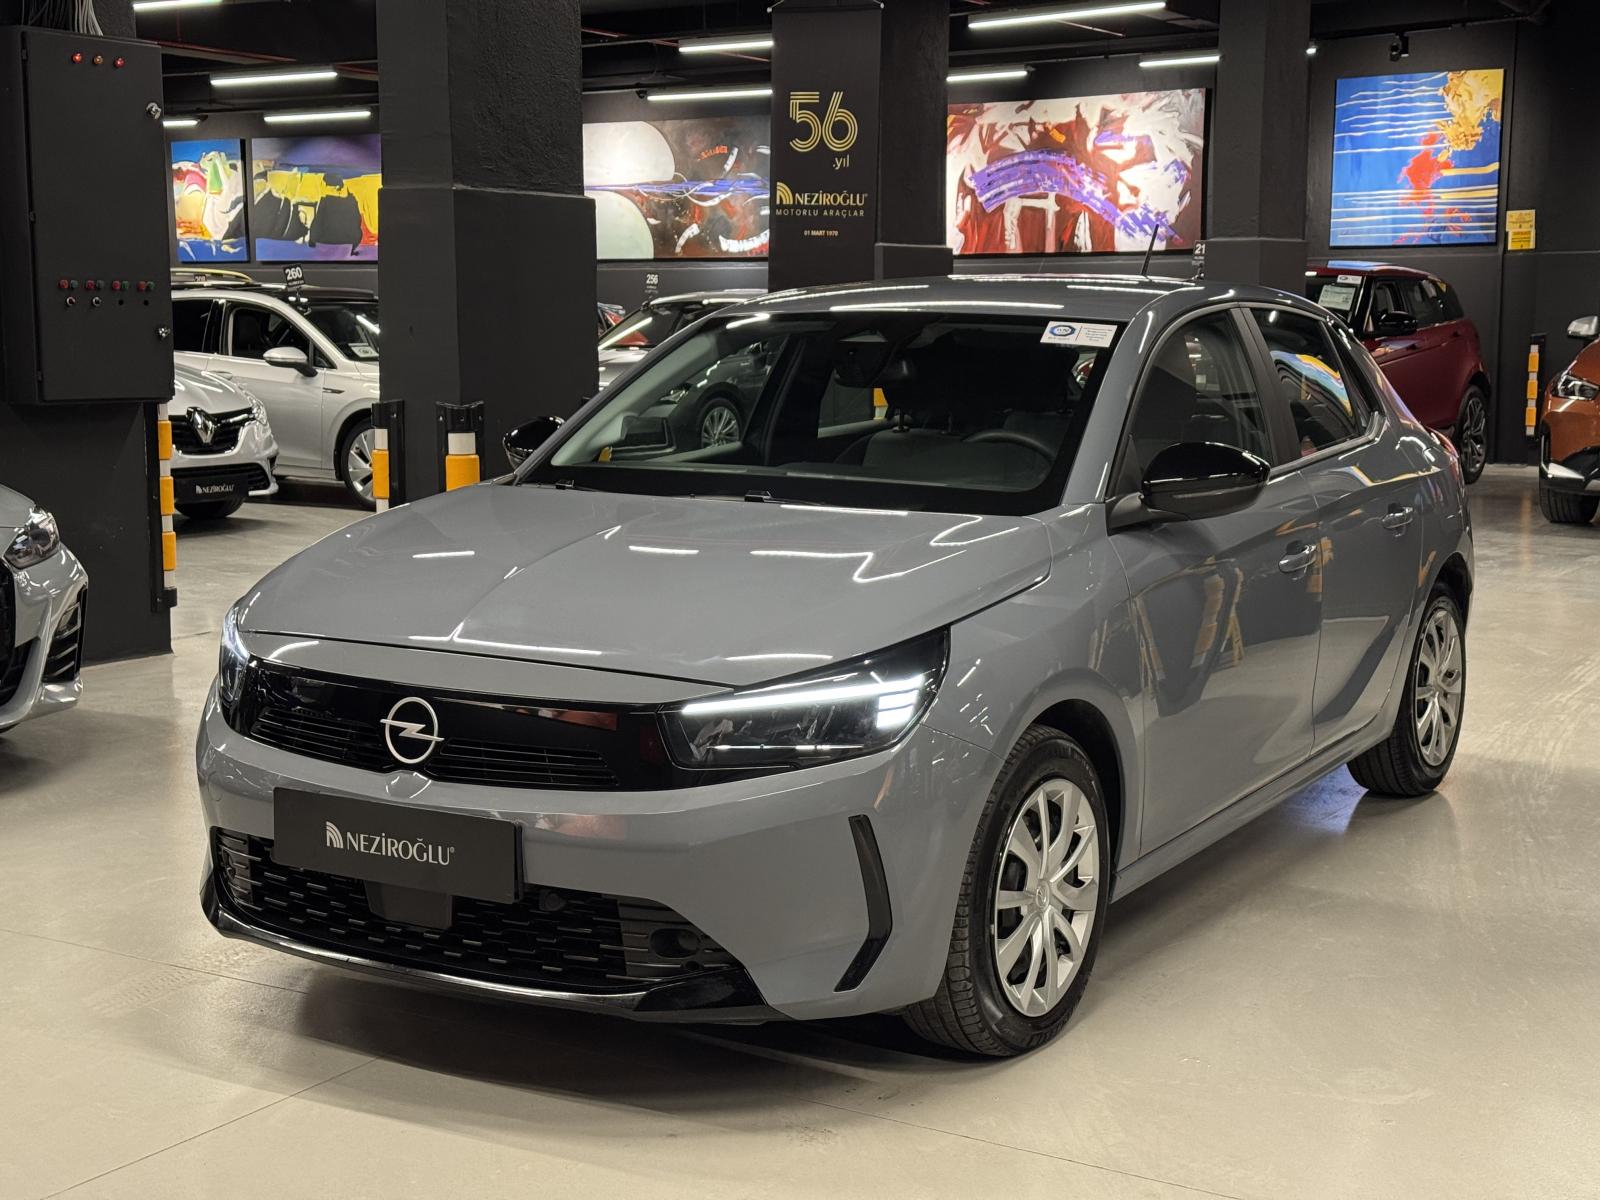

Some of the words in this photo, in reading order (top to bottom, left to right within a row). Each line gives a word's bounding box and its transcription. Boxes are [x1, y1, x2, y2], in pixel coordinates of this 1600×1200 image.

[789, 91, 858, 152] 56
[794, 190, 865, 206] NEZİROĞLU
[775, 208, 819, 216] MOTORLU
[822, 209, 865, 218] ARAÇLAR
[285, 266, 303, 280] 260
[346, 831, 451, 866] NEZİROĞLU
